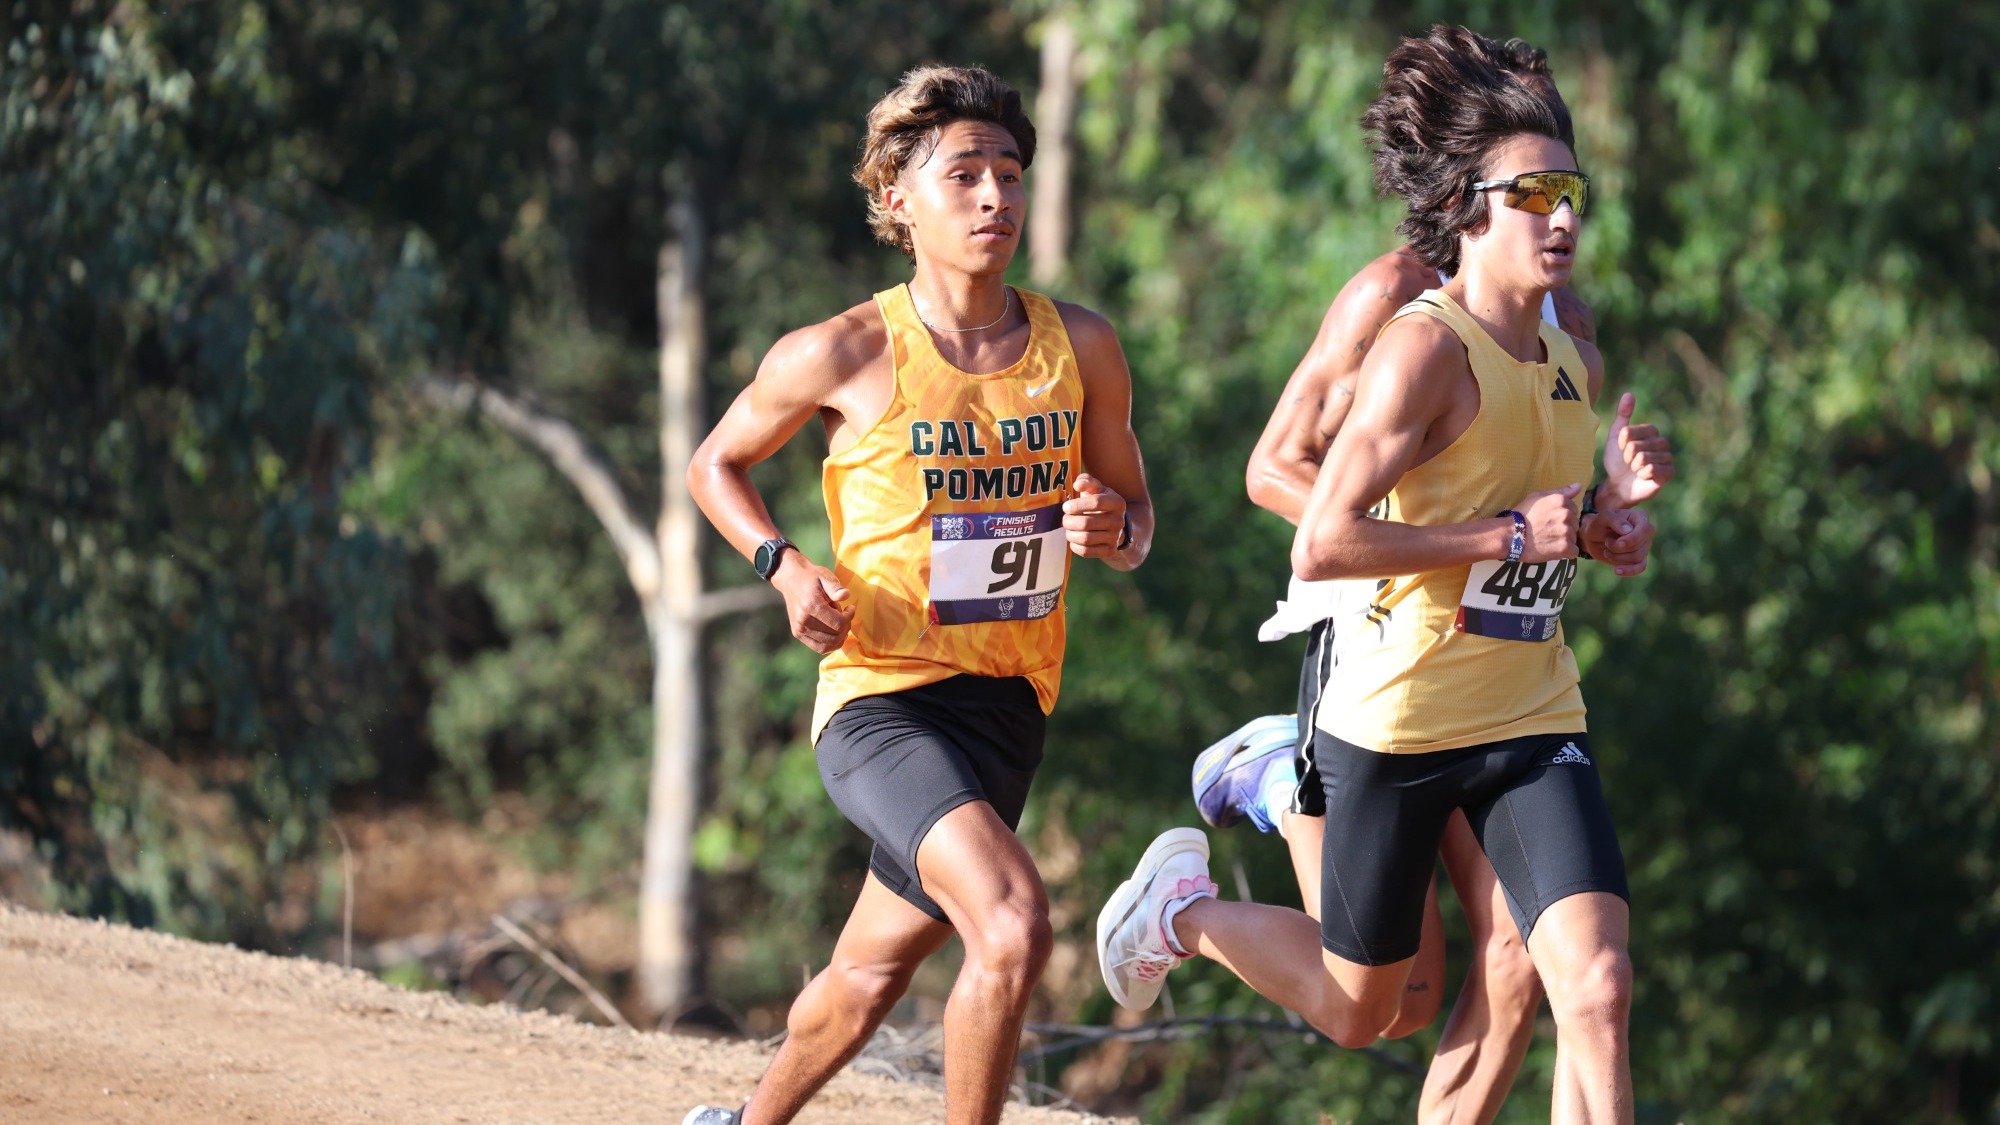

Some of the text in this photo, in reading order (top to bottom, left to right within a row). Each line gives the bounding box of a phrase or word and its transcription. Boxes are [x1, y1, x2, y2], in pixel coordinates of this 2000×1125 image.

[911, 410, 1079, 457] CAL POLY
[922, 459, 1069, 502] POMONA
[994, 525, 1034, 537] RESULTS
[996, 514, 1036, 527] FINISHED
[987, 537, 1043, 594] 91
[1481, 558, 1577, 608] 4848
[1552, 754, 1591, 766] adidas
